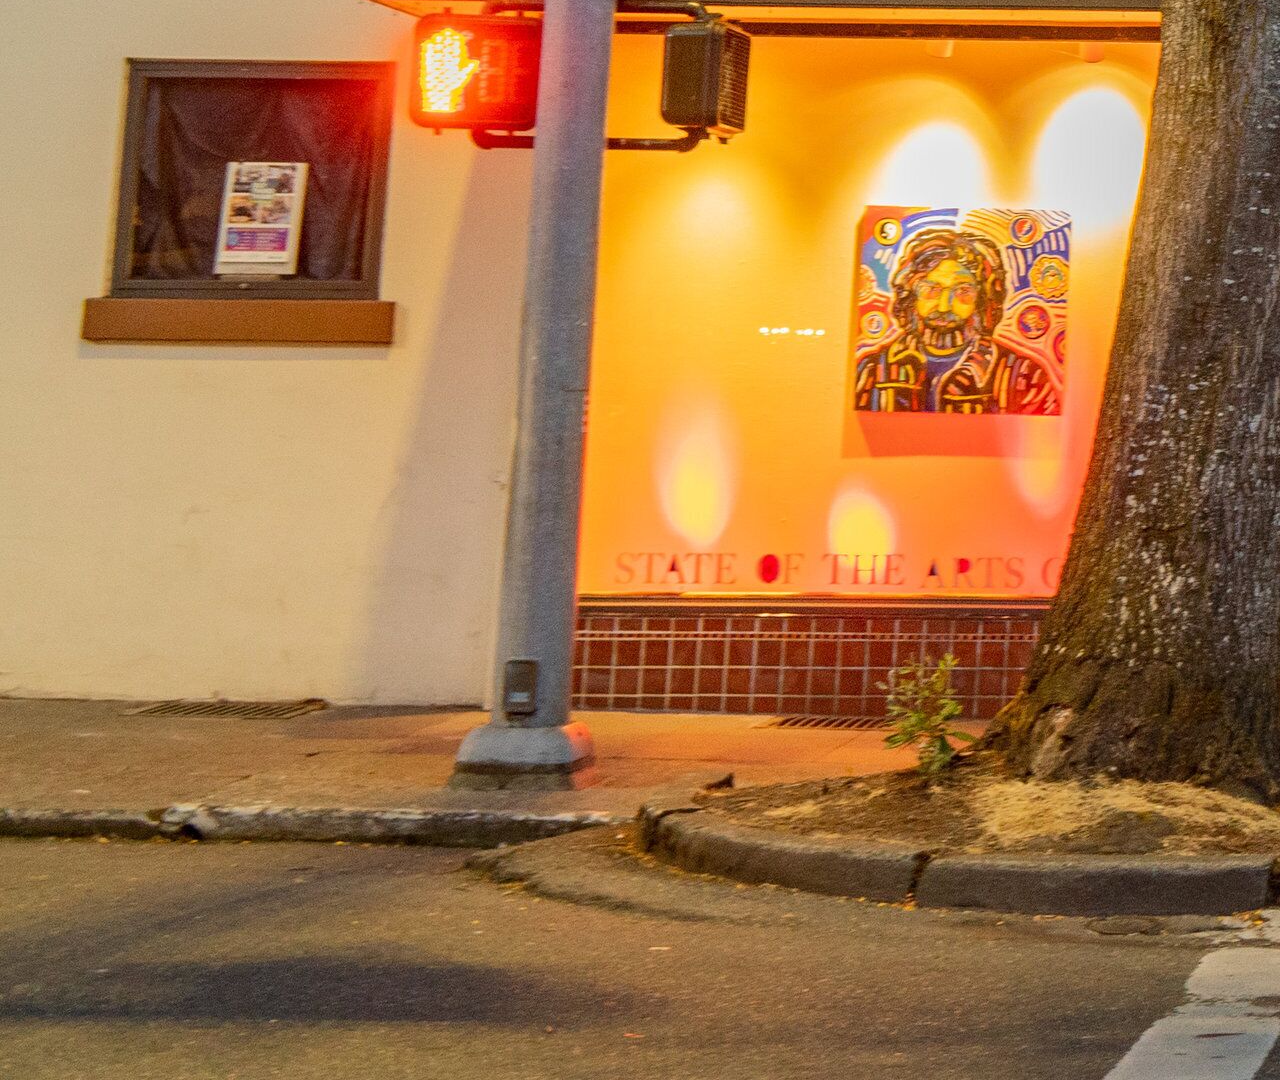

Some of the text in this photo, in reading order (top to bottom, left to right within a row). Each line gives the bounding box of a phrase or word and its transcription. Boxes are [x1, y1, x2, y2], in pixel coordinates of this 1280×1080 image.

[615, 552, 737, 586] STATE
[757, 553, 805, 585] OF
[822, 554, 904, 586] THE
[919, 557, 1025, 590] ARTS
